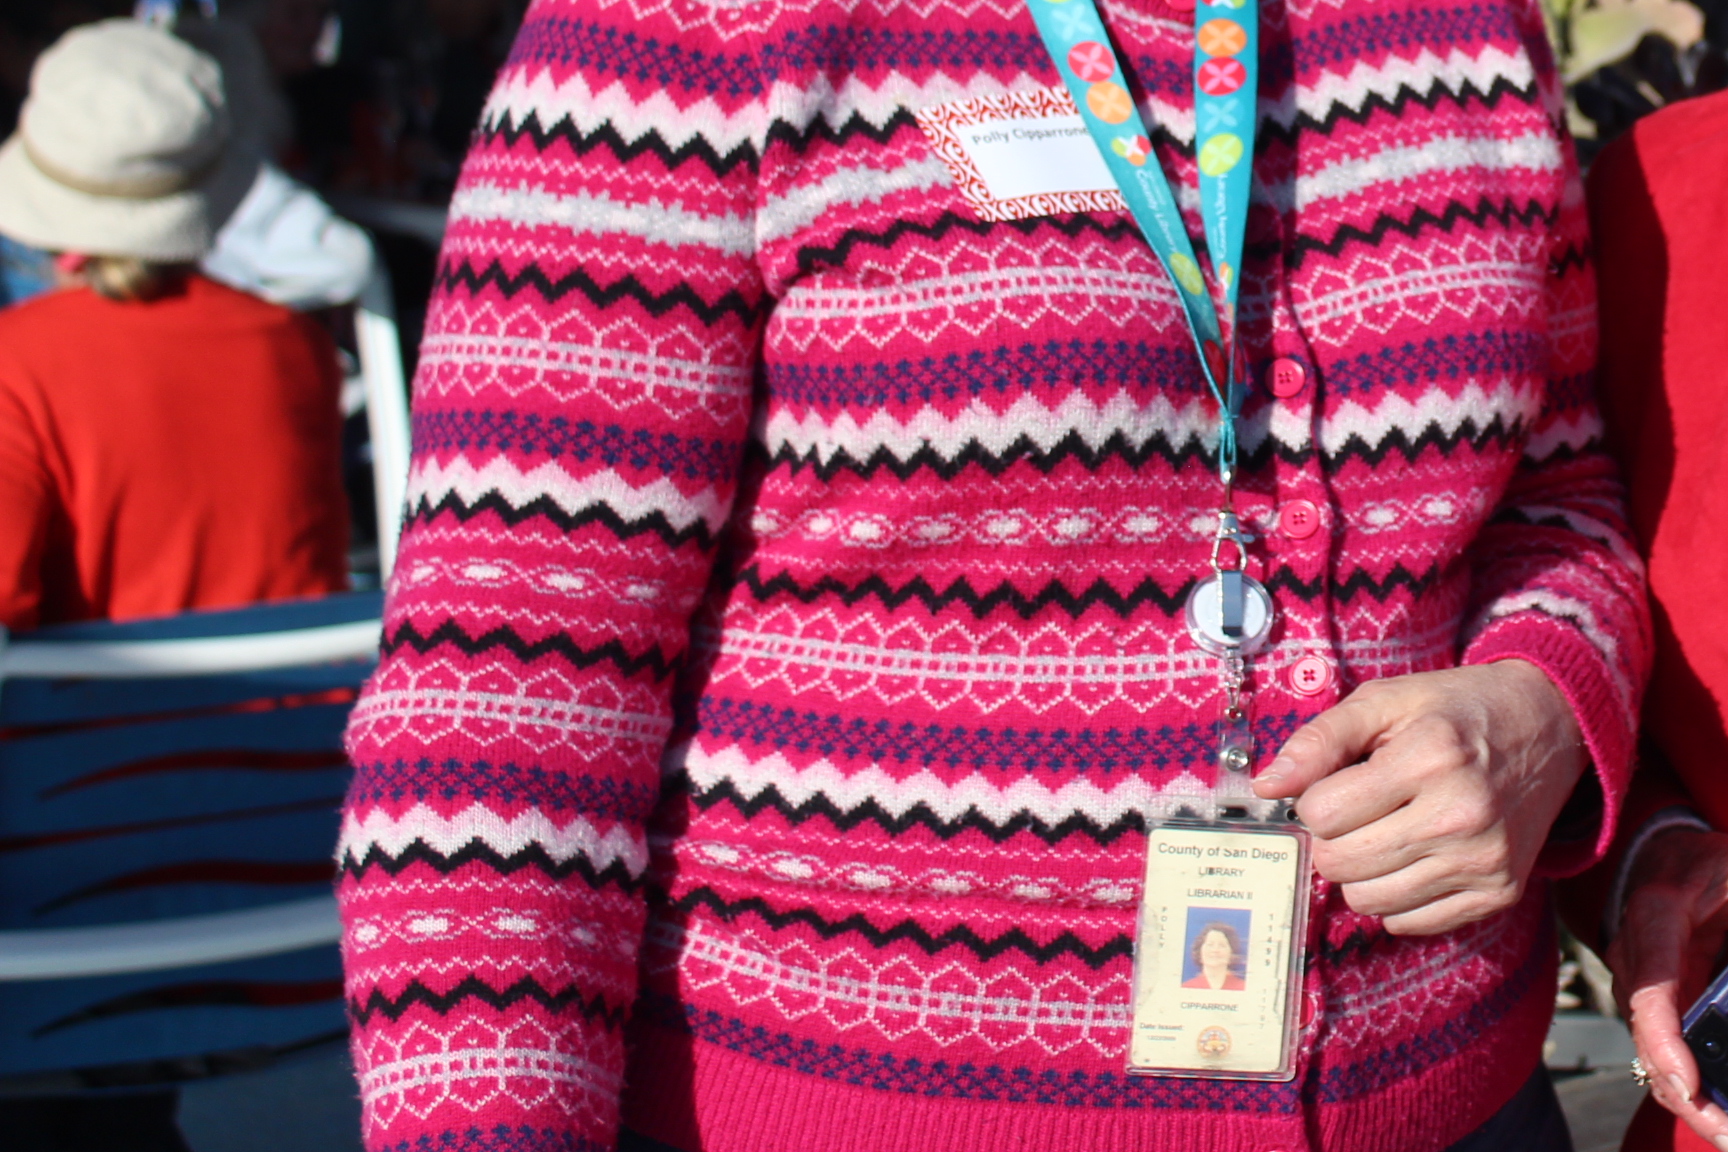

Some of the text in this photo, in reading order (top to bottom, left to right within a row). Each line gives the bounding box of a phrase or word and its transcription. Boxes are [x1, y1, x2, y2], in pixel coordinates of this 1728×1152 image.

[972, 129, 1010, 145] Polly
[1157, 841, 1289, 863] County of San Diego
[1187, 888, 1244, 900] LIBRARIAN
